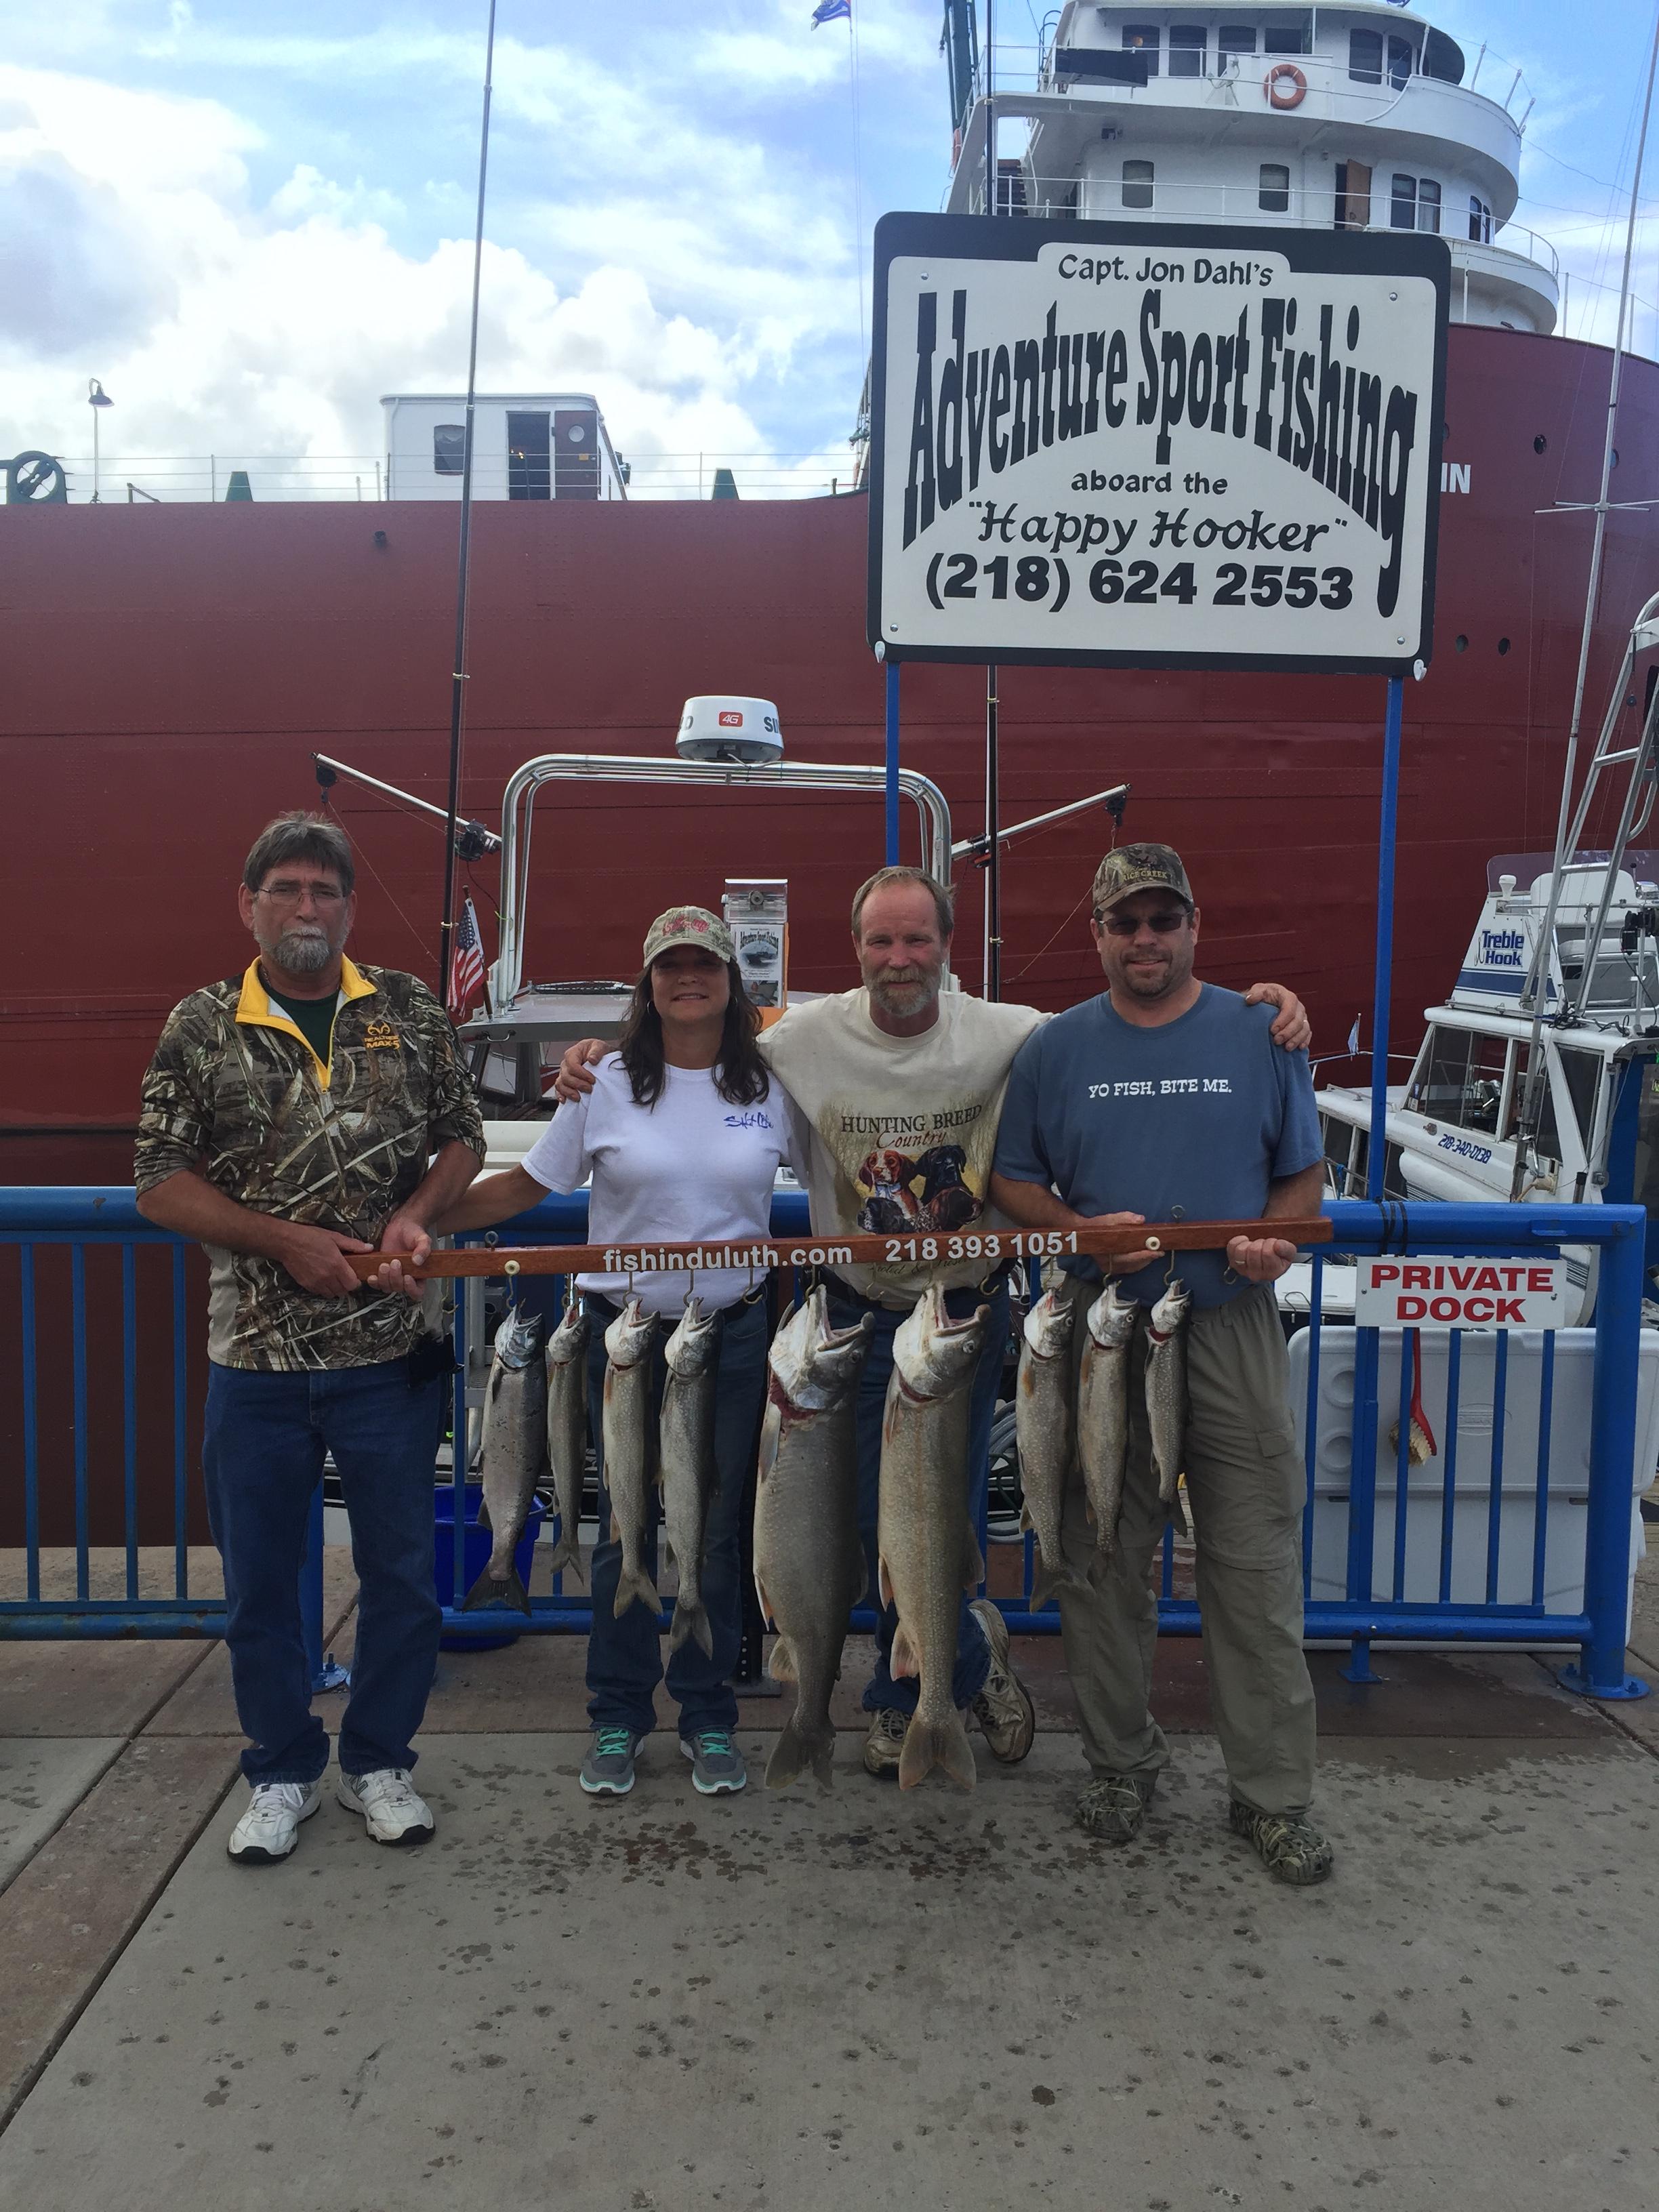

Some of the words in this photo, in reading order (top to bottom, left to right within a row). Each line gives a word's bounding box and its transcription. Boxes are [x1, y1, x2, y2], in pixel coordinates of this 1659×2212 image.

[1059, 253, 1129, 285] Capt.
[1136, 257, 1185, 283] Jon
[1194, 258, 1273, 286] Dahl's
[903, 289, 1128, 551] Adventure
[1136, 288, 1250, 465] Sport
[1254, 298, 1418, 619] Fishing
[1071, 470, 1172, 494] aboard
[1183, 472, 1229, 495] the
[1441, 462, 1471, 494] IN
[968, 500, 1138, 555] "Happy
[1149, 508, 1349, 552] Hooker"
[926, 552, 1071, 613] (218)
[1088, 558, 1197, 605] 624
[1212, 562, 1353, 611] 2553
[722, 714, 740, 724] 4G
[763, 716, 779, 733] SI
[1481, 929, 1525, 949] Treble
[1484, 949, 1523, 966] Hook
[1088, 1084, 1109, 1099] YO
[1113, 1082, 1155, 1097] FISH,
[1160, 1079, 1198, 1094] BITE
[1202, 1079, 1232, 1093] ME.
[840, 1115, 926, 1134] HUNTING
[933, 1105, 983, 1130] BREED
[876, 1126, 947, 1149] Country
[602, 1244, 853, 1273] fishinduluth.com
[884, 1237, 939, 1262] 218
[947, 1234, 1000, 1259] 393
[1010, 1231, 1078, 1256] 1051
[1371, 1264, 1554, 1292] PRIVATE
[1396, 1296, 1527, 1323] DOCK
